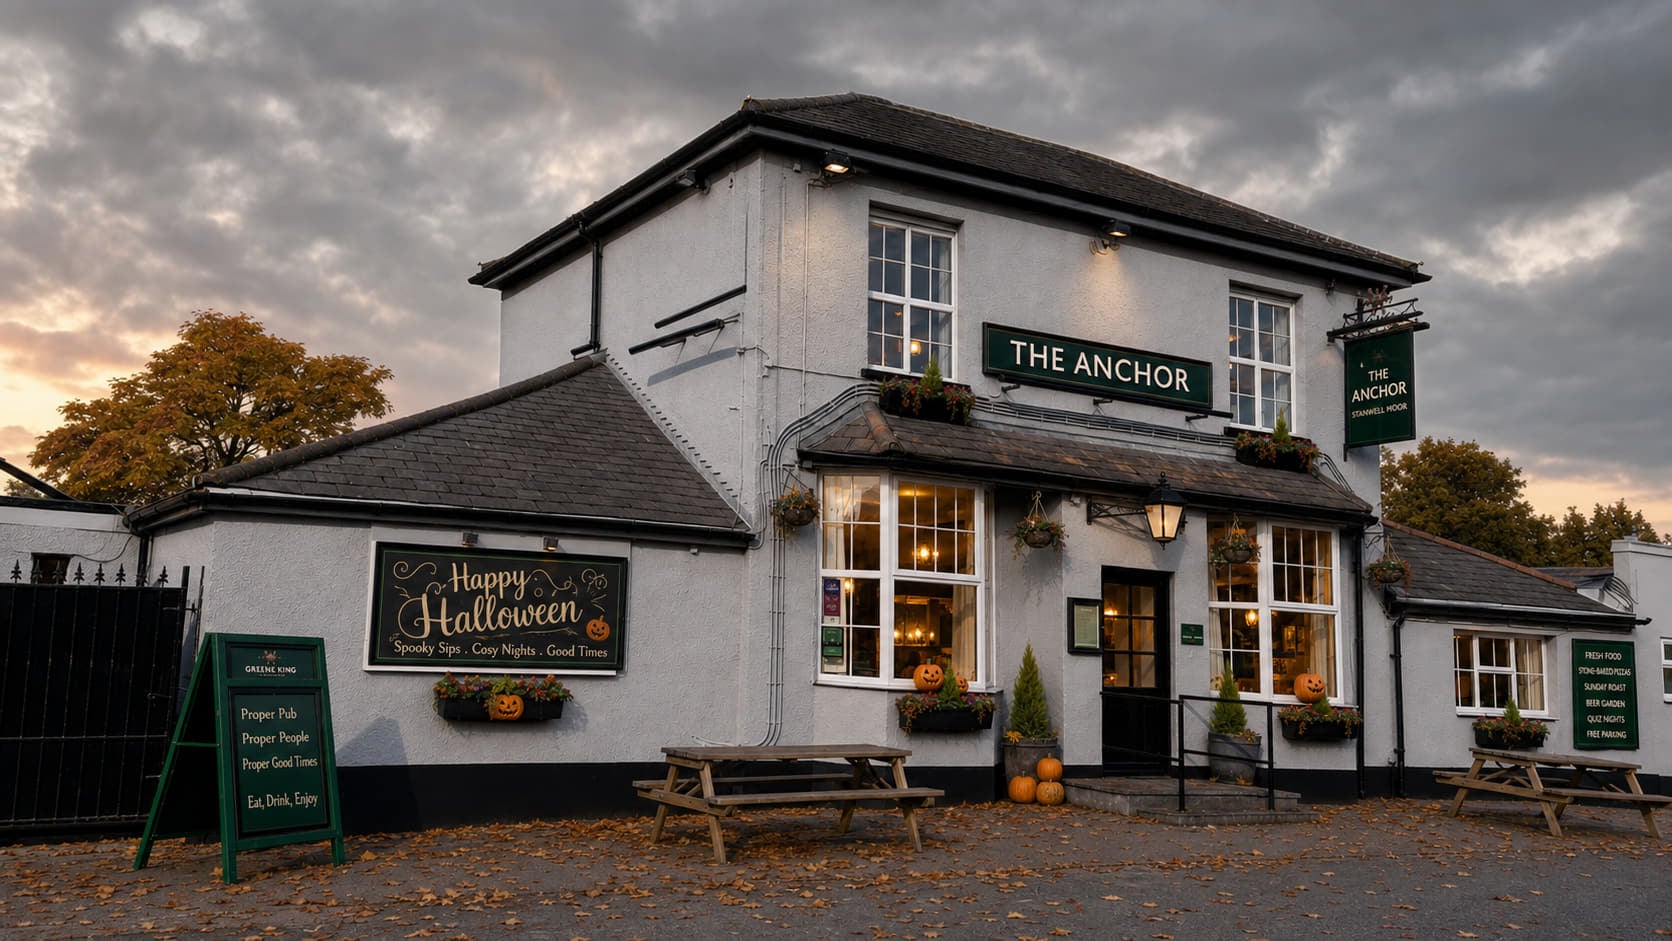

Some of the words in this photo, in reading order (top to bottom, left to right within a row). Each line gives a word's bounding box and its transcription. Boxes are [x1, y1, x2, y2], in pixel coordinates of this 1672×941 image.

[1009, 339, 1065, 372] THE
[1073, 351, 1190, 393] ANCHOR
[1368, 368, 1389, 381] THE
[1351, 381, 1407, 403] ANCHOR
[1352, 407, 1385, 418] STANWELL
[448, 562, 531, 600] Happy
[397, 593, 583, 639] Halloween
[394, 640, 435, 656] Spooky
[438, 641, 461, 657] Sips
[471, 642, 498, 657] Cosy
[501, 644, 536, 659] Nights
[546, 644, 575, 657] Good
[577, 645, 608, 658] Times
[1584, 651, 1603, 660] FRESH
[1604, 652, 1622, 660] FOOD
[245, 665, 276, 673] GREENE
[1584, 682, 1607, 690] SUNDAY
[1607, 683, 1626, 691] ROAST
[1586, 699, 1600, 707] BEER
[1601, 699, 1626, 708] GARDEN
[241, 707, 275, 722] Proper
[278, 707, 297, 719] Pub
[1587, 714, 1602, 724] QUIZ
[242, 732, 276, 747] Proper
[279, 730, 309, 746] People
[1586, 730, 1600, 738] FREE
[242, 757, 270, 772] Proper
[271, 756, 293, 768] Good
[294, 755, 317, 767] Times
[248, 795, 264, 810] Eat,
[266, 793, 292, 807] Drink,
[294, 792, 318, 808] Enjoy
